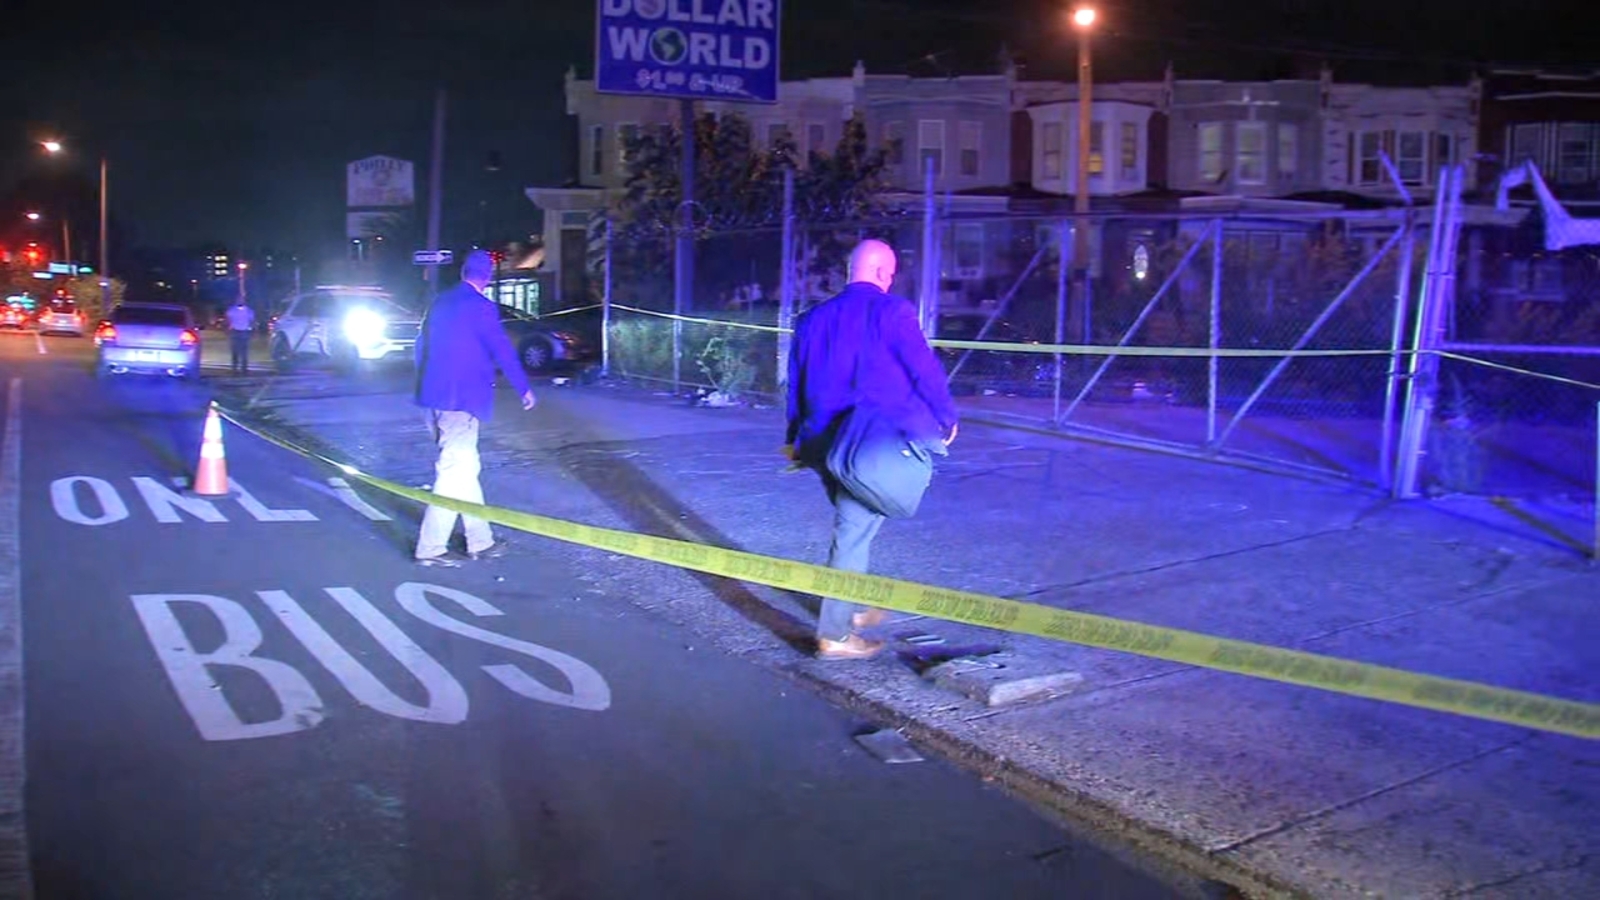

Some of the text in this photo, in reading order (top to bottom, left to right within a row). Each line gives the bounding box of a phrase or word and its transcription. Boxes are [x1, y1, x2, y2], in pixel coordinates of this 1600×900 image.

[608, 27, 770, 69] WORLD
[50, 475, 392, 525] ONLY
[130, 581, 612, 741] BUS
